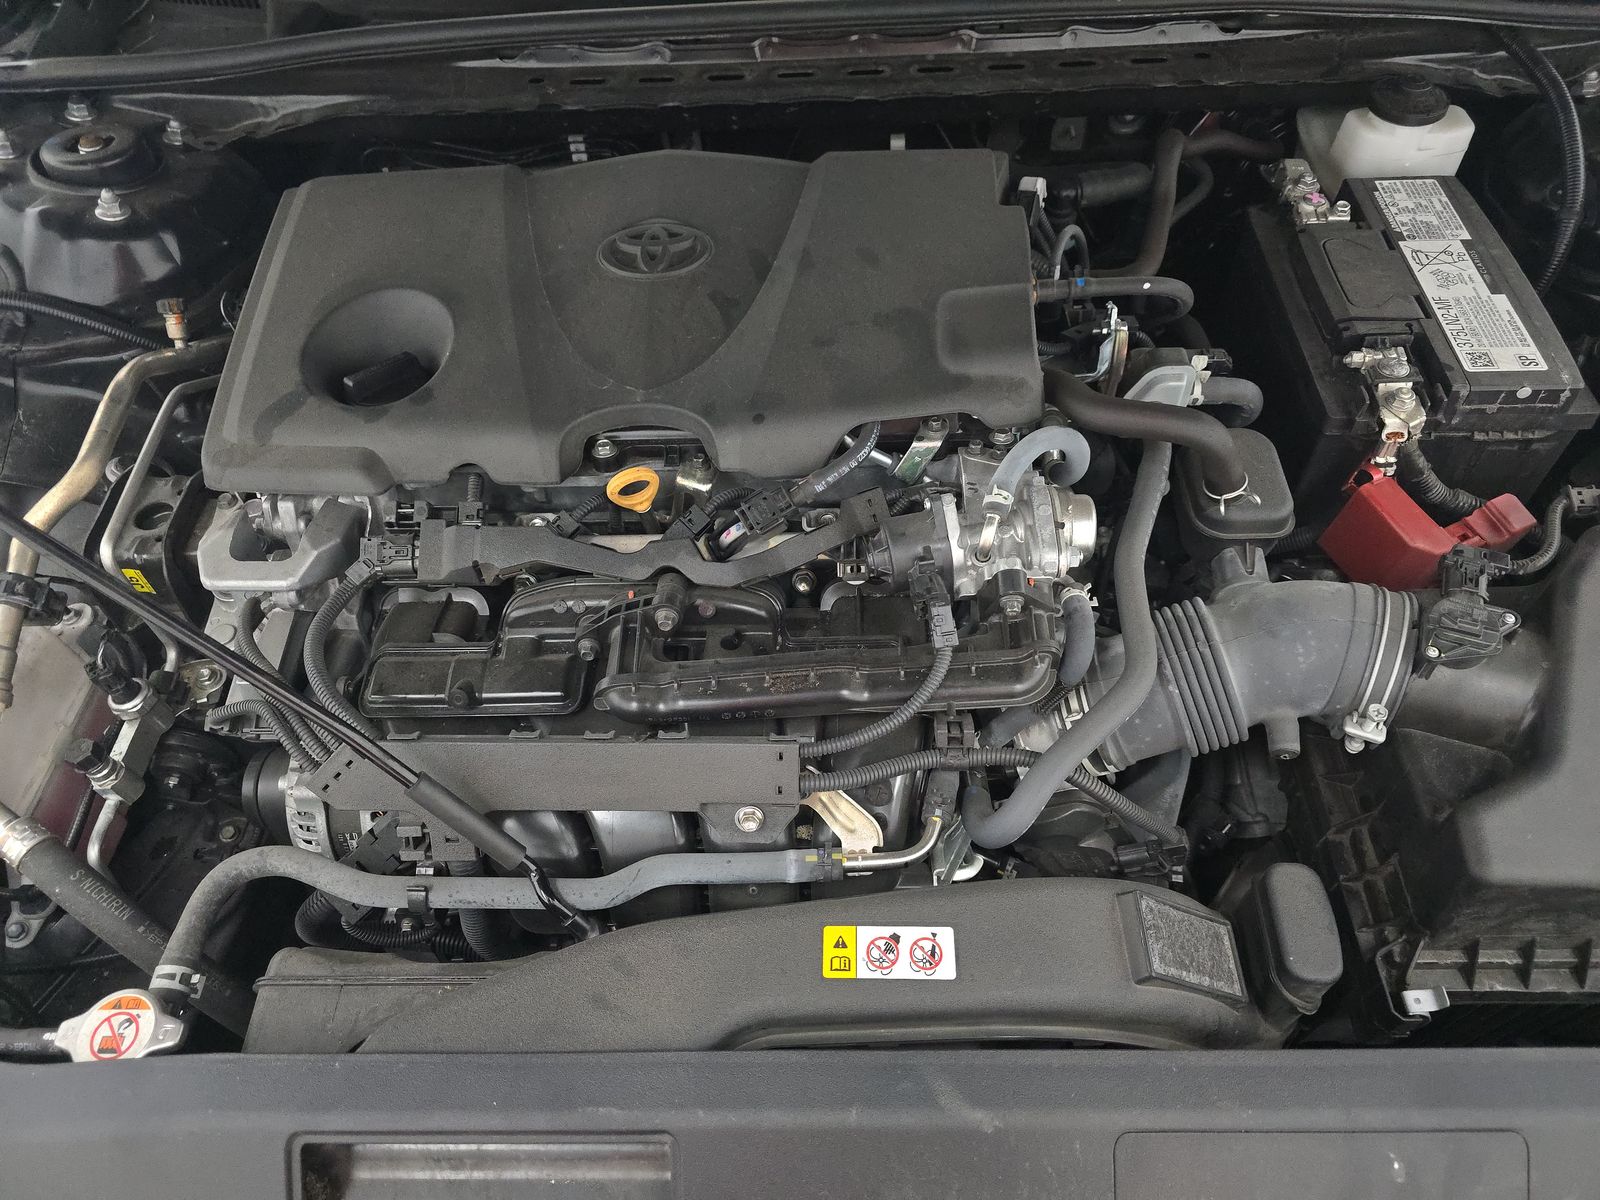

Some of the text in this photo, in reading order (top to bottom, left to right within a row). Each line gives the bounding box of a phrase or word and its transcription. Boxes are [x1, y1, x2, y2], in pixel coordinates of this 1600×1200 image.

[1457, 252, 1468, 262] Pb
[1432, 296, 1474, 348] 375LN2-MF
[1518, 355, 1539, 367] SP
